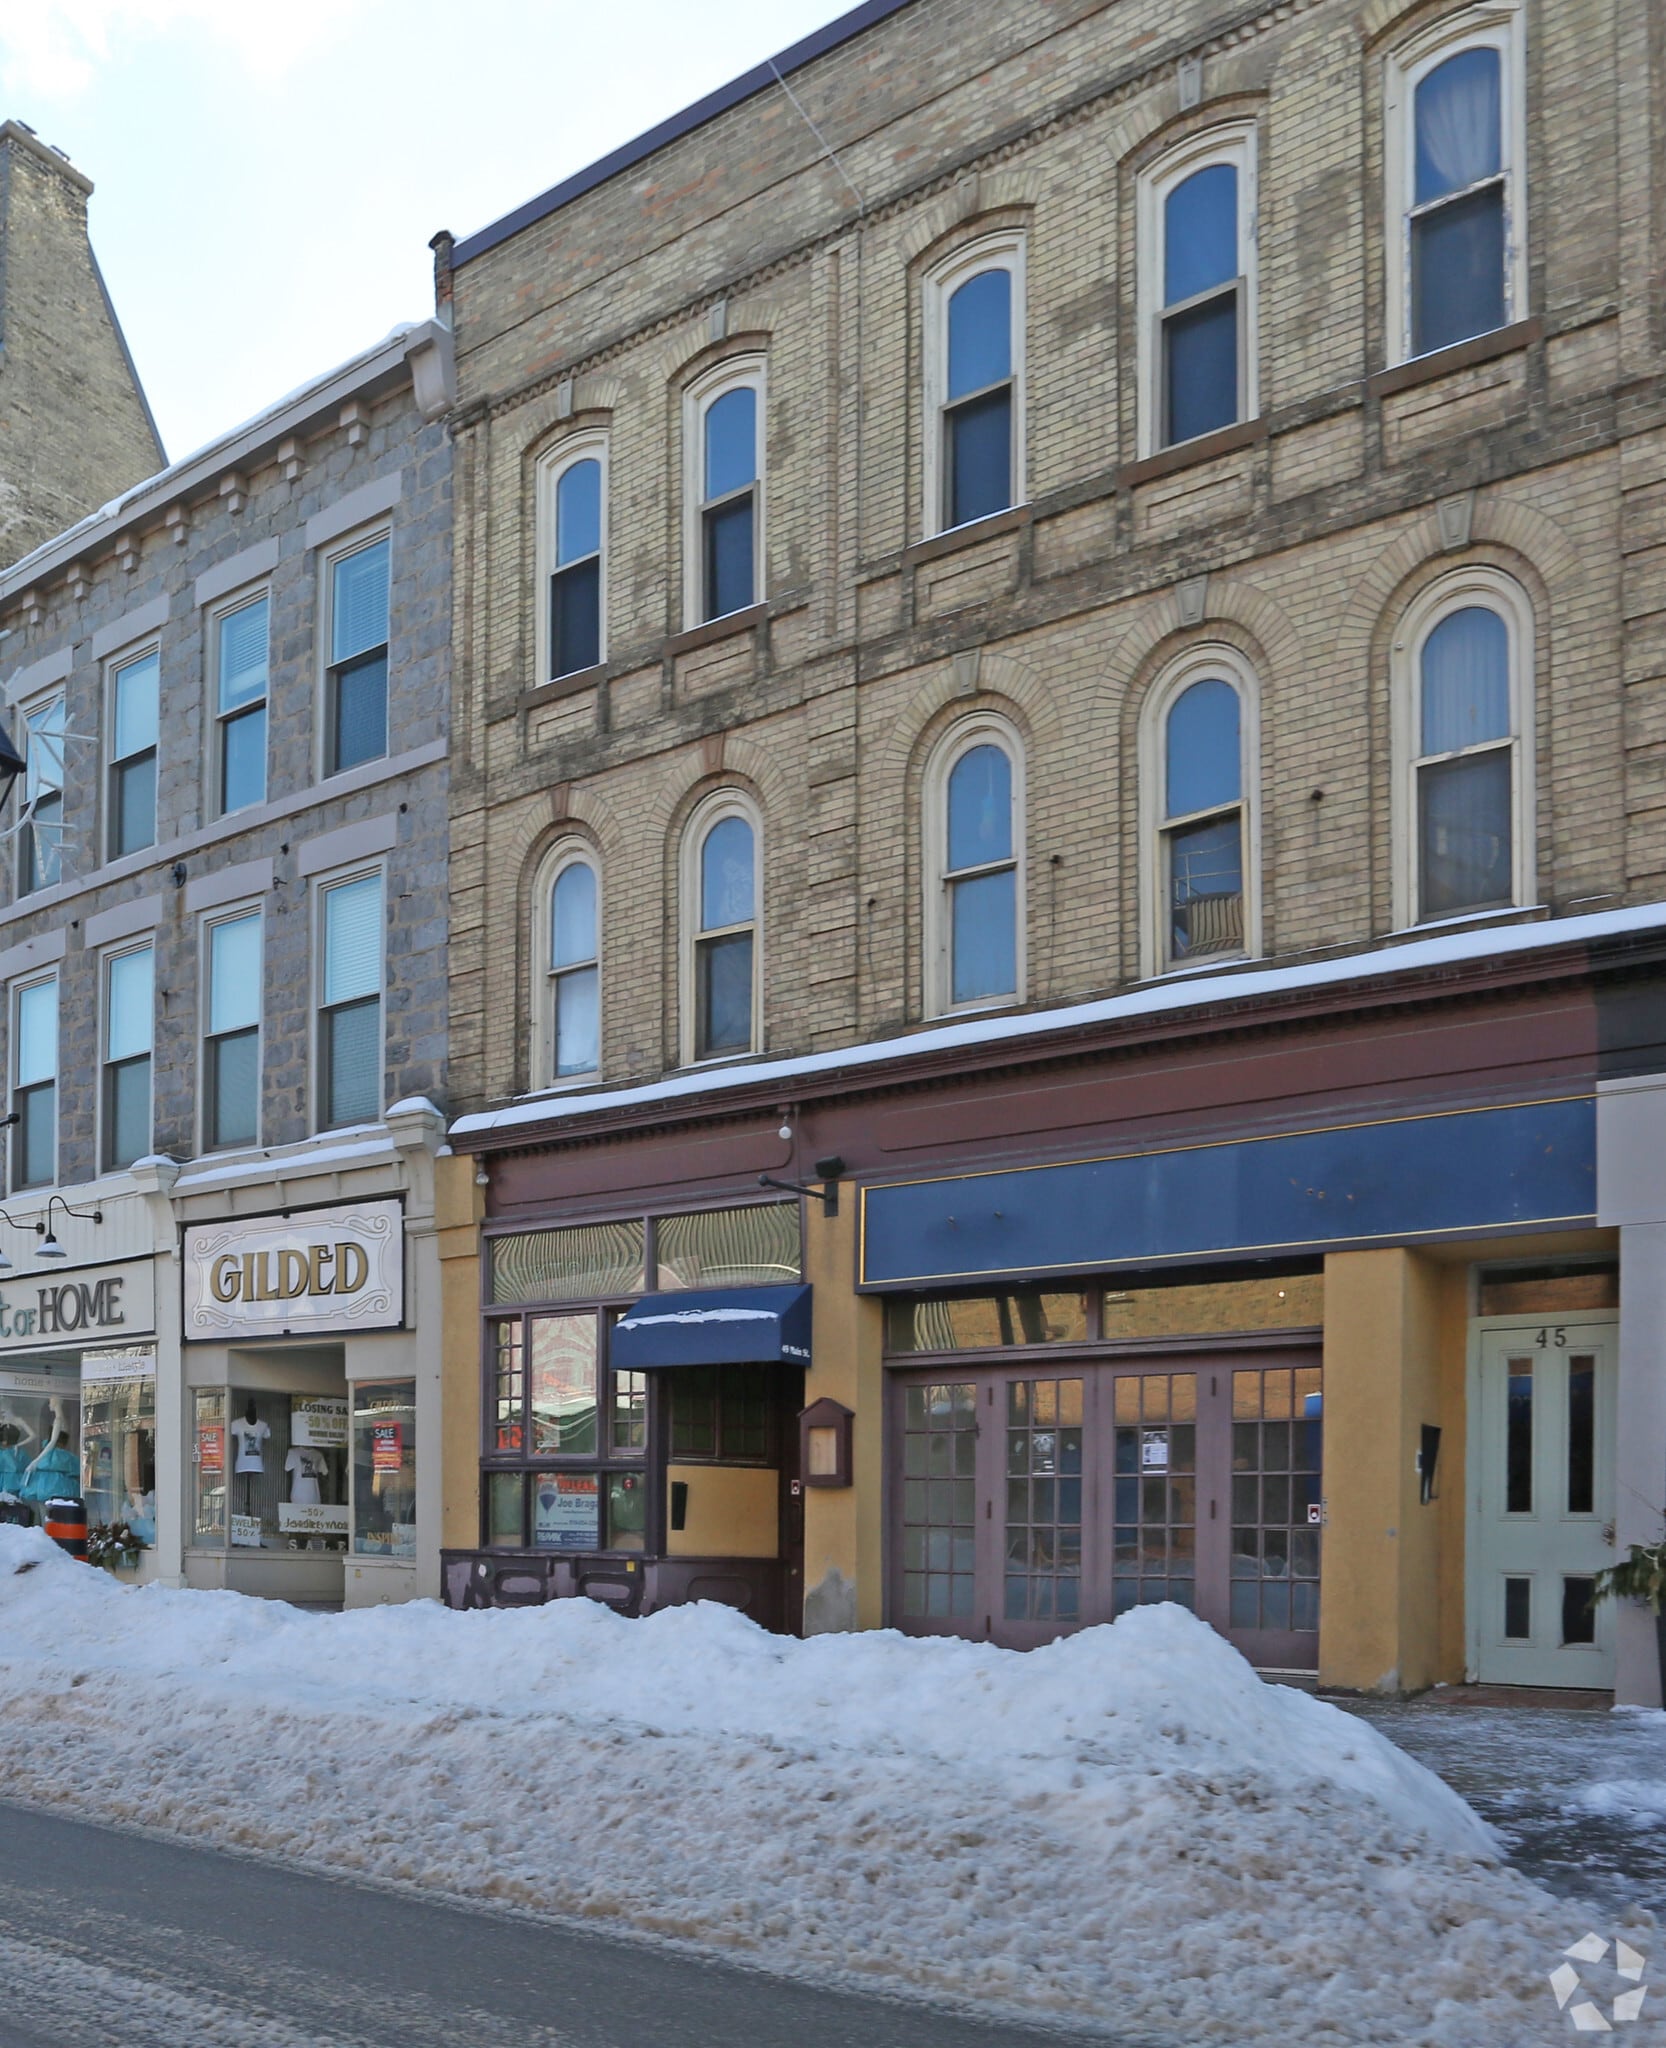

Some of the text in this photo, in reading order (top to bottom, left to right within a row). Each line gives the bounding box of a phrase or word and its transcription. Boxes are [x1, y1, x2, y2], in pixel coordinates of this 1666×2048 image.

[210, 1242, 369, 1303] GILDED
[13, 1308, 37, 1336] OF
[37, 1277, 125, 1334] HOME
[1536, 1328, 1567, 1348] 45
[201, 1432, 217, 1442] SALE
[374, 1428, 395, 1439] SALE
